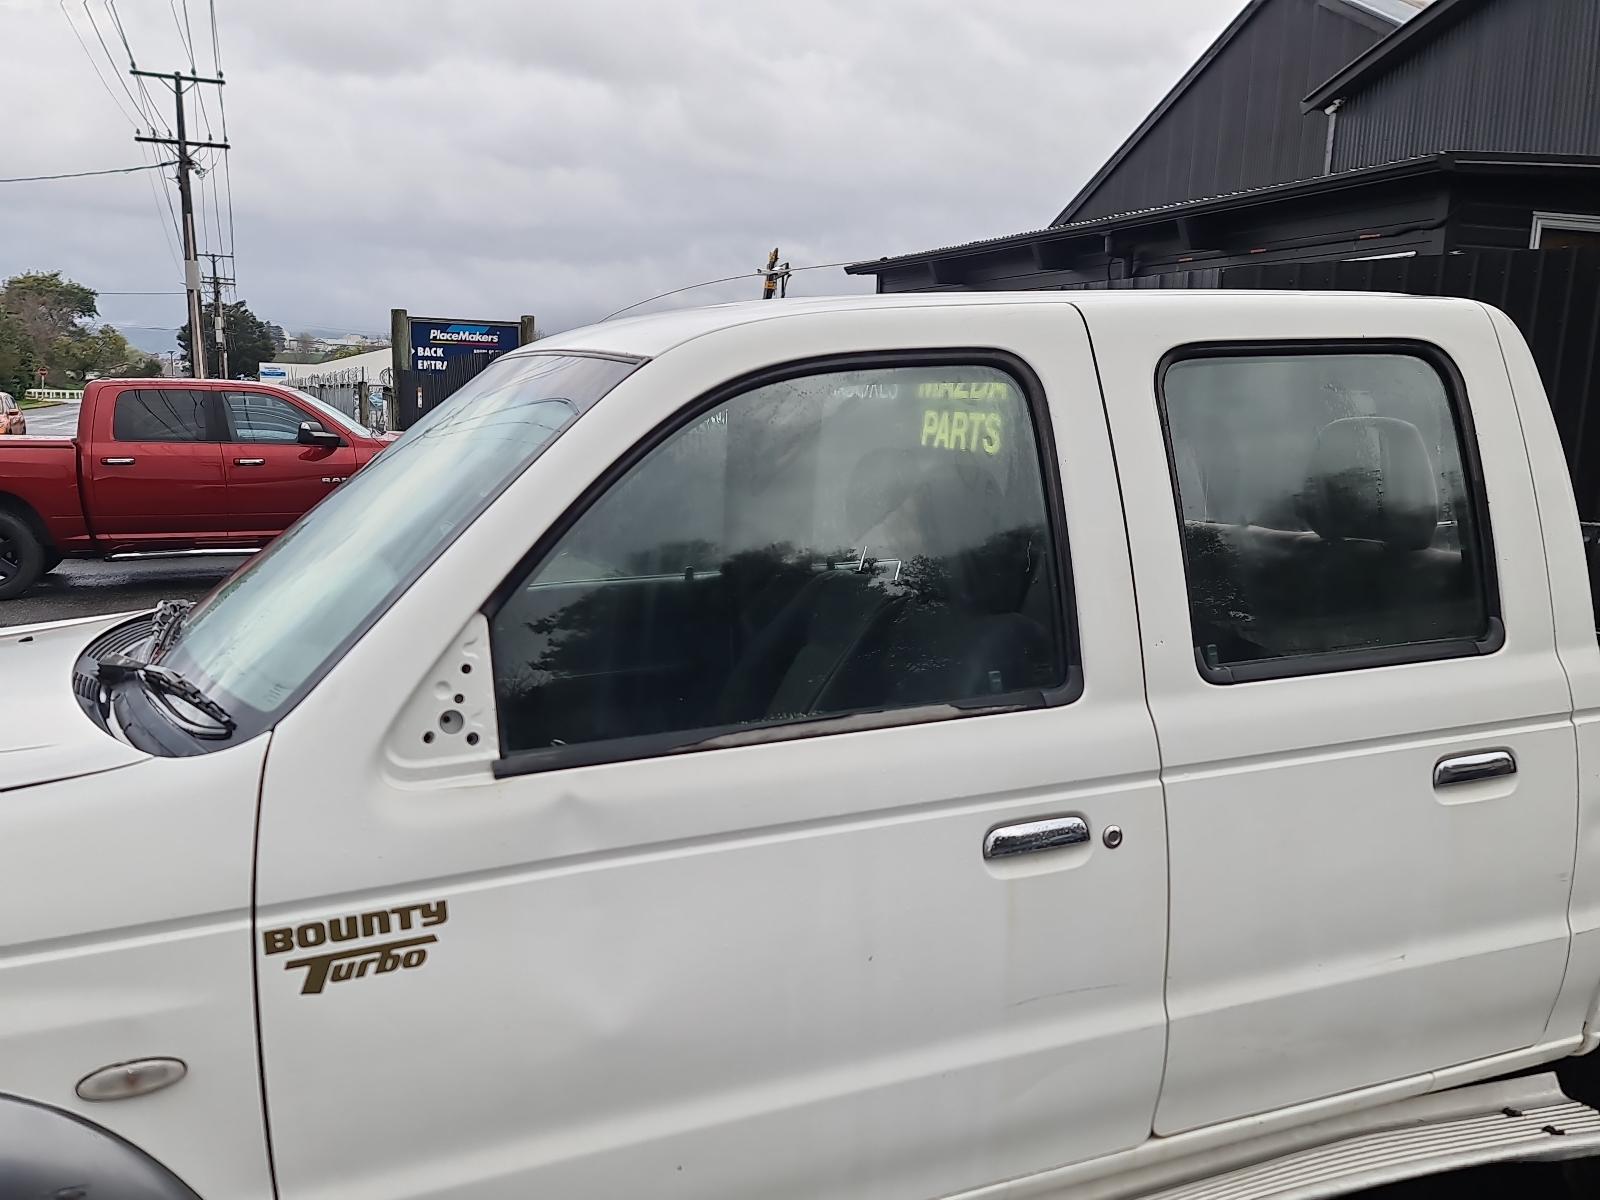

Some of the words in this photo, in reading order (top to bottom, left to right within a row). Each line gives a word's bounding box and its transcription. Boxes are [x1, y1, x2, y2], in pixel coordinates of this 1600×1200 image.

[417, 346, 444, 357] BACK
[429, 329, 498, 343] PlaceMakers
[921, 409, 1002, 455] PARTS
[264, 900, 447, 955] BOUNTY
[285, 934, 437, 995] Turbo
